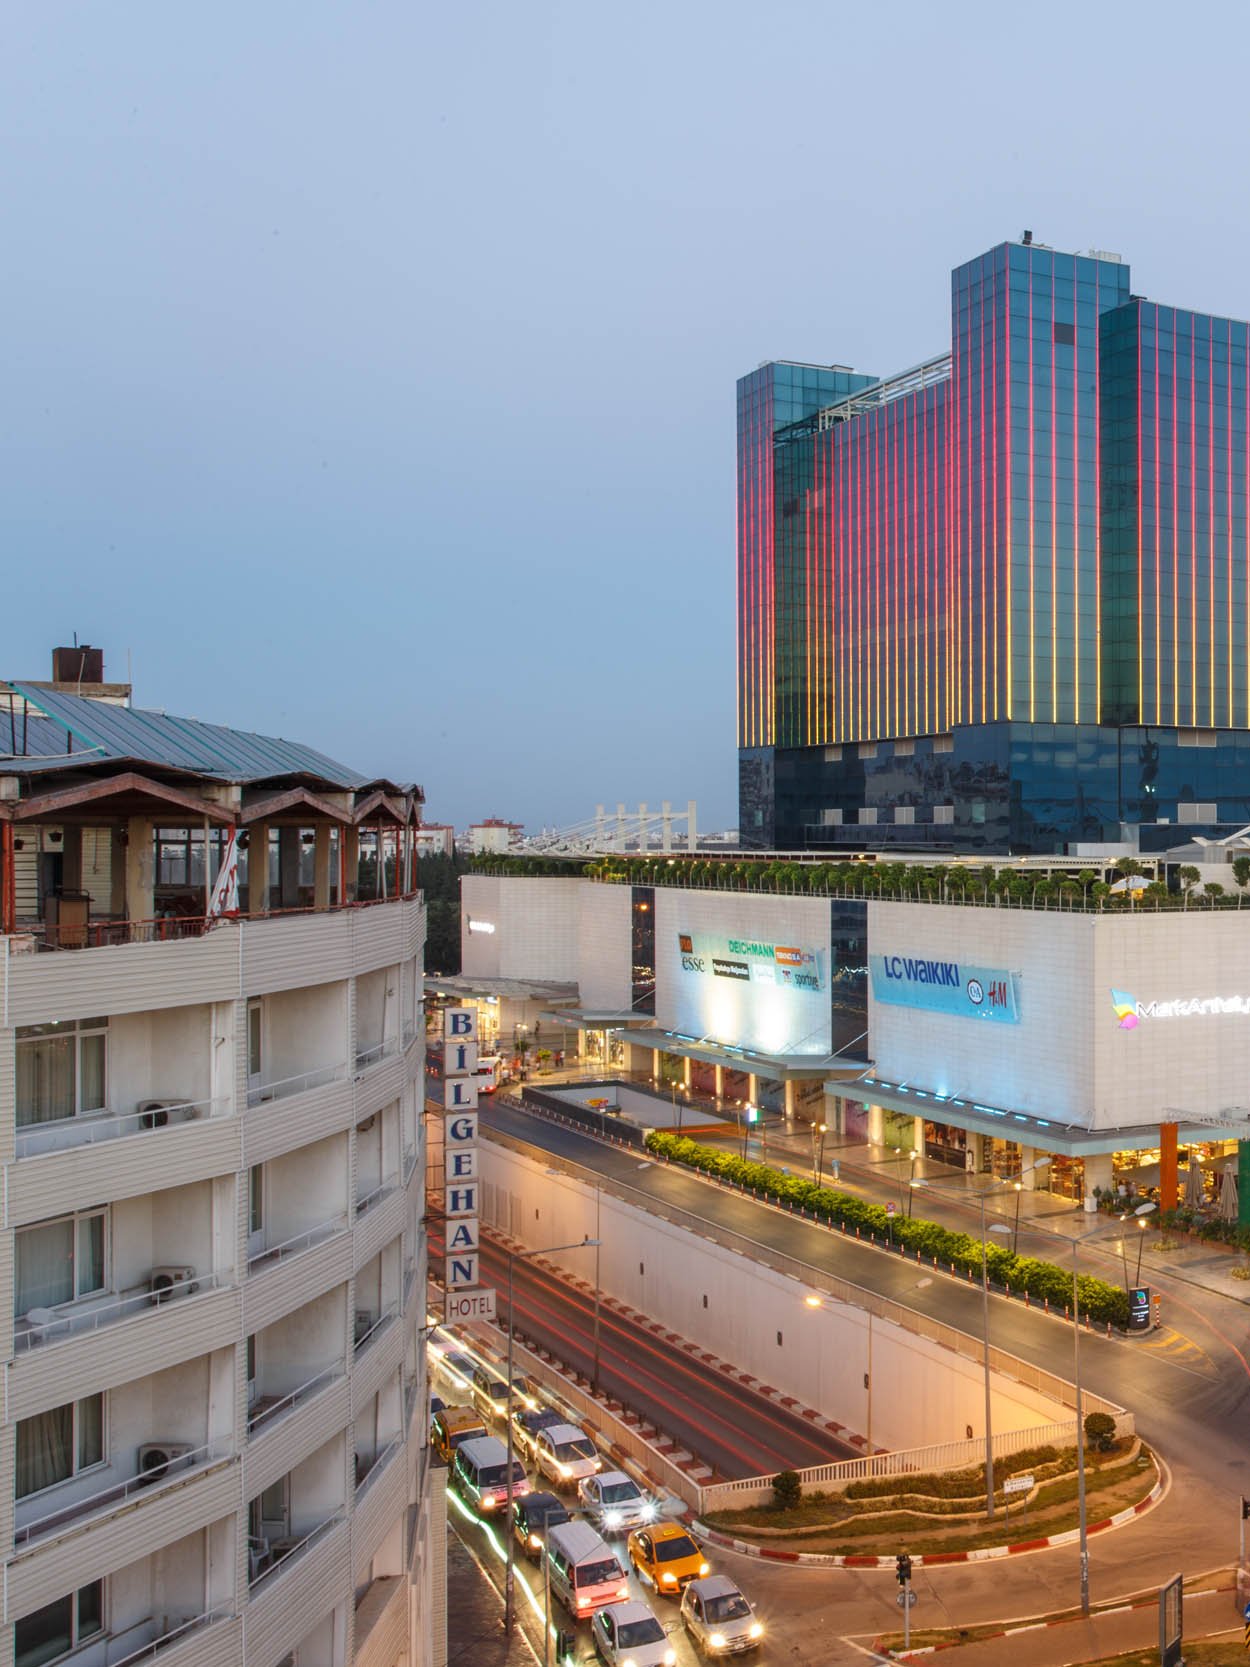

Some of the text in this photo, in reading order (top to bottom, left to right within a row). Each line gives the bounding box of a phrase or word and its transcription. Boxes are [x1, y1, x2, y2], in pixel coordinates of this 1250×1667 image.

[728, 939, 775, 958] DEICHMANN
[682, 956, 705, 973] esse
[884, 956, 903, 980] LC
[449, 1012, 475, 1283] BİLGEHAN
[450, 1297, 493, 1320] HOTEL
